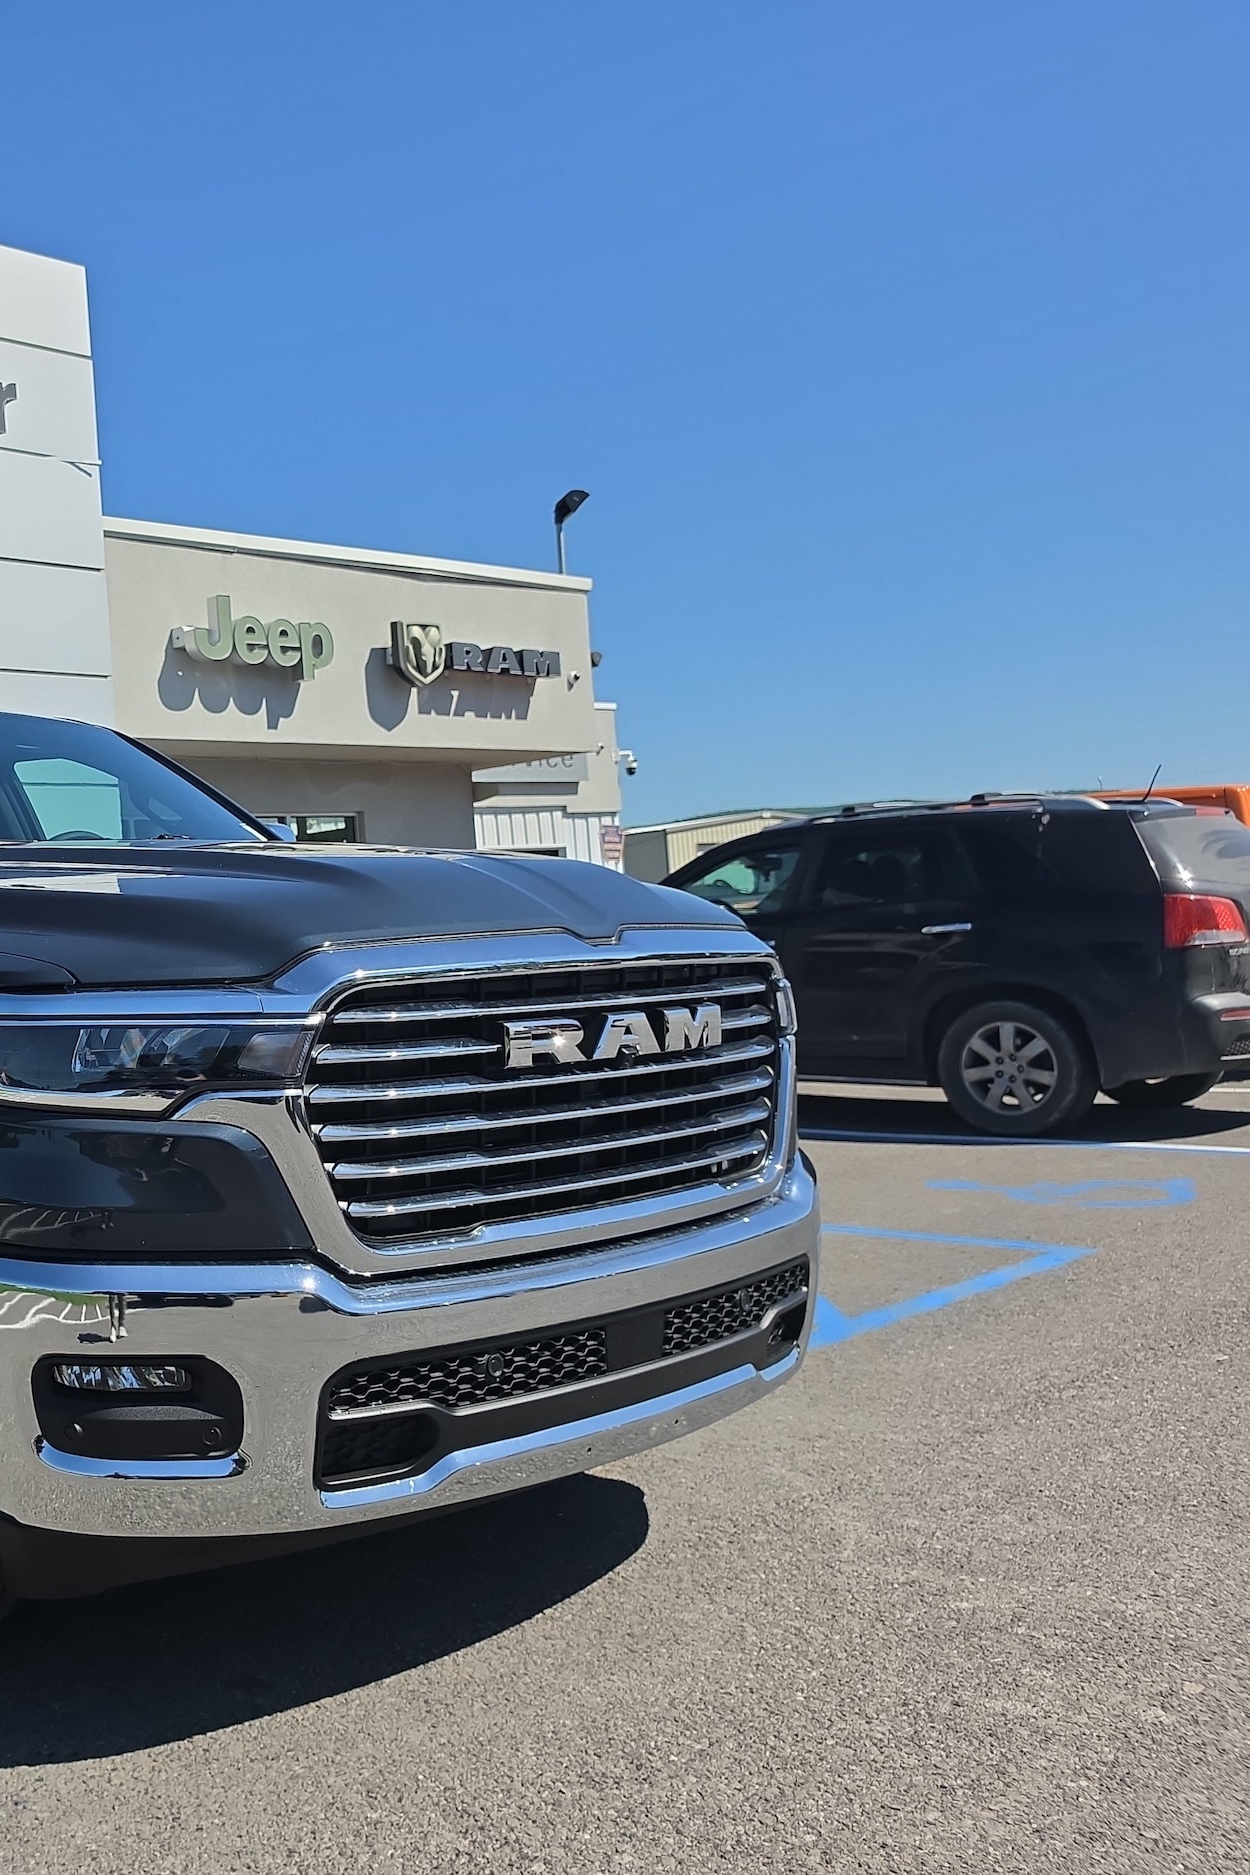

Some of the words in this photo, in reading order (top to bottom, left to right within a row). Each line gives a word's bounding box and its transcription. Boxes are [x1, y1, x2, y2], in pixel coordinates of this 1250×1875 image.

[185, 595, 334, 682] Jeep
[447, 641, 562, 678] RAM
[502, 1002, 723, 1069] RAM
